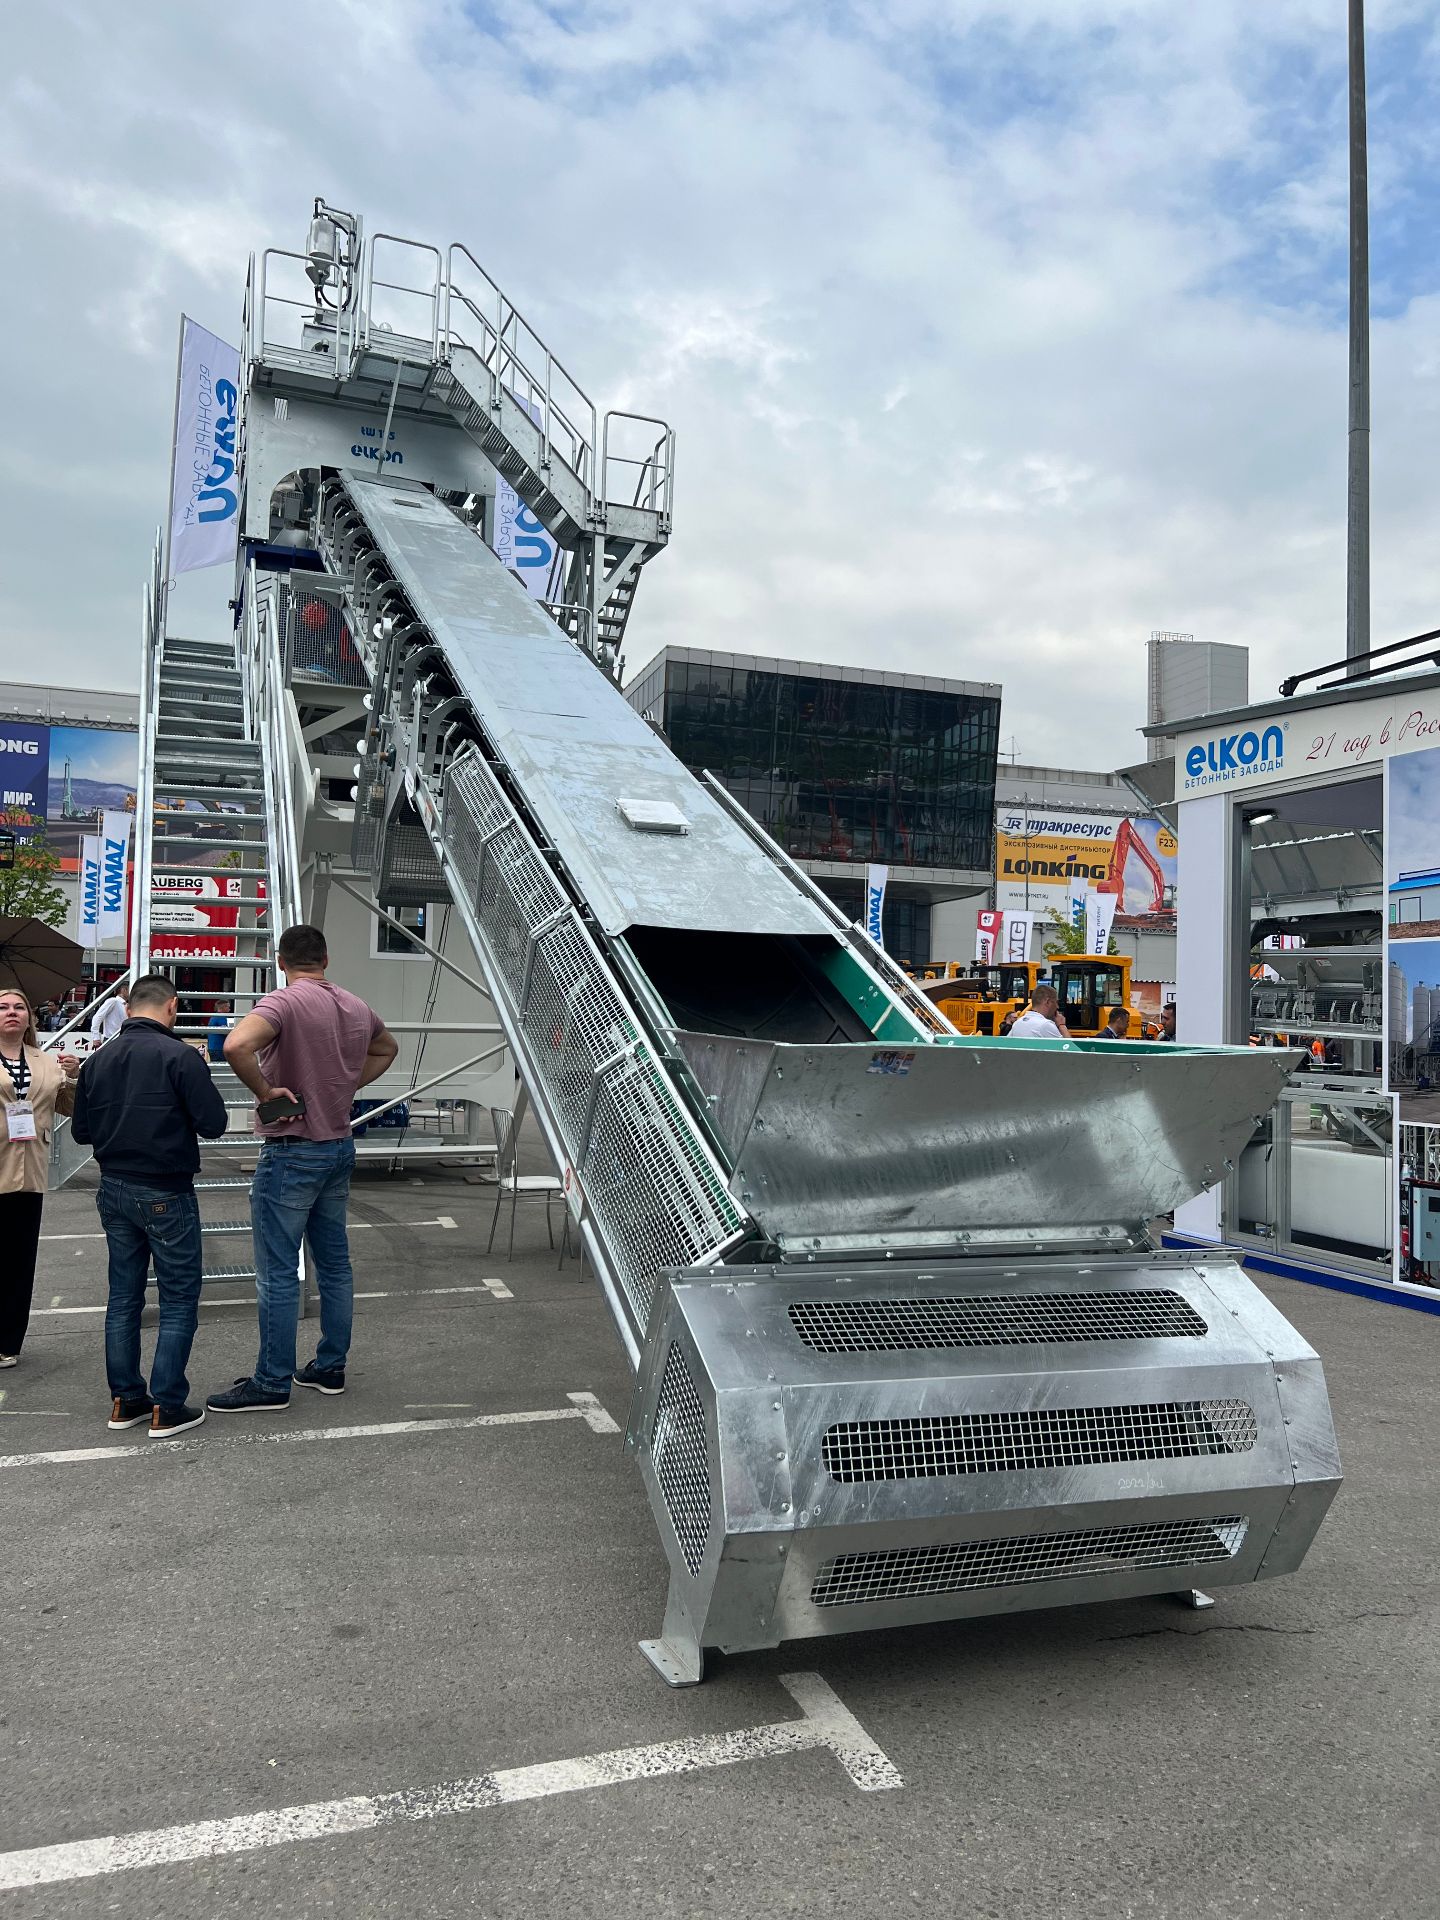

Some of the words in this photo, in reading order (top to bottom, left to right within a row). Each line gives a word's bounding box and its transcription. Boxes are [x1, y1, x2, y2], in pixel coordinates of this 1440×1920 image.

[1305, 732, 1337, 761] 21
[1343, 734, 1372, 761] год
[1184, 768, 1237, 789] БЕТОННЫЕ
[1240, 758, 1284, 777] ЗАВОДЫ
[3, 790, 36, 806] МИР.
[1026, 818, 1113, 838] тракресурс
[103, 837, 126, 912] KAMAZ
[83, 859, 101, 925] KAMAZ
